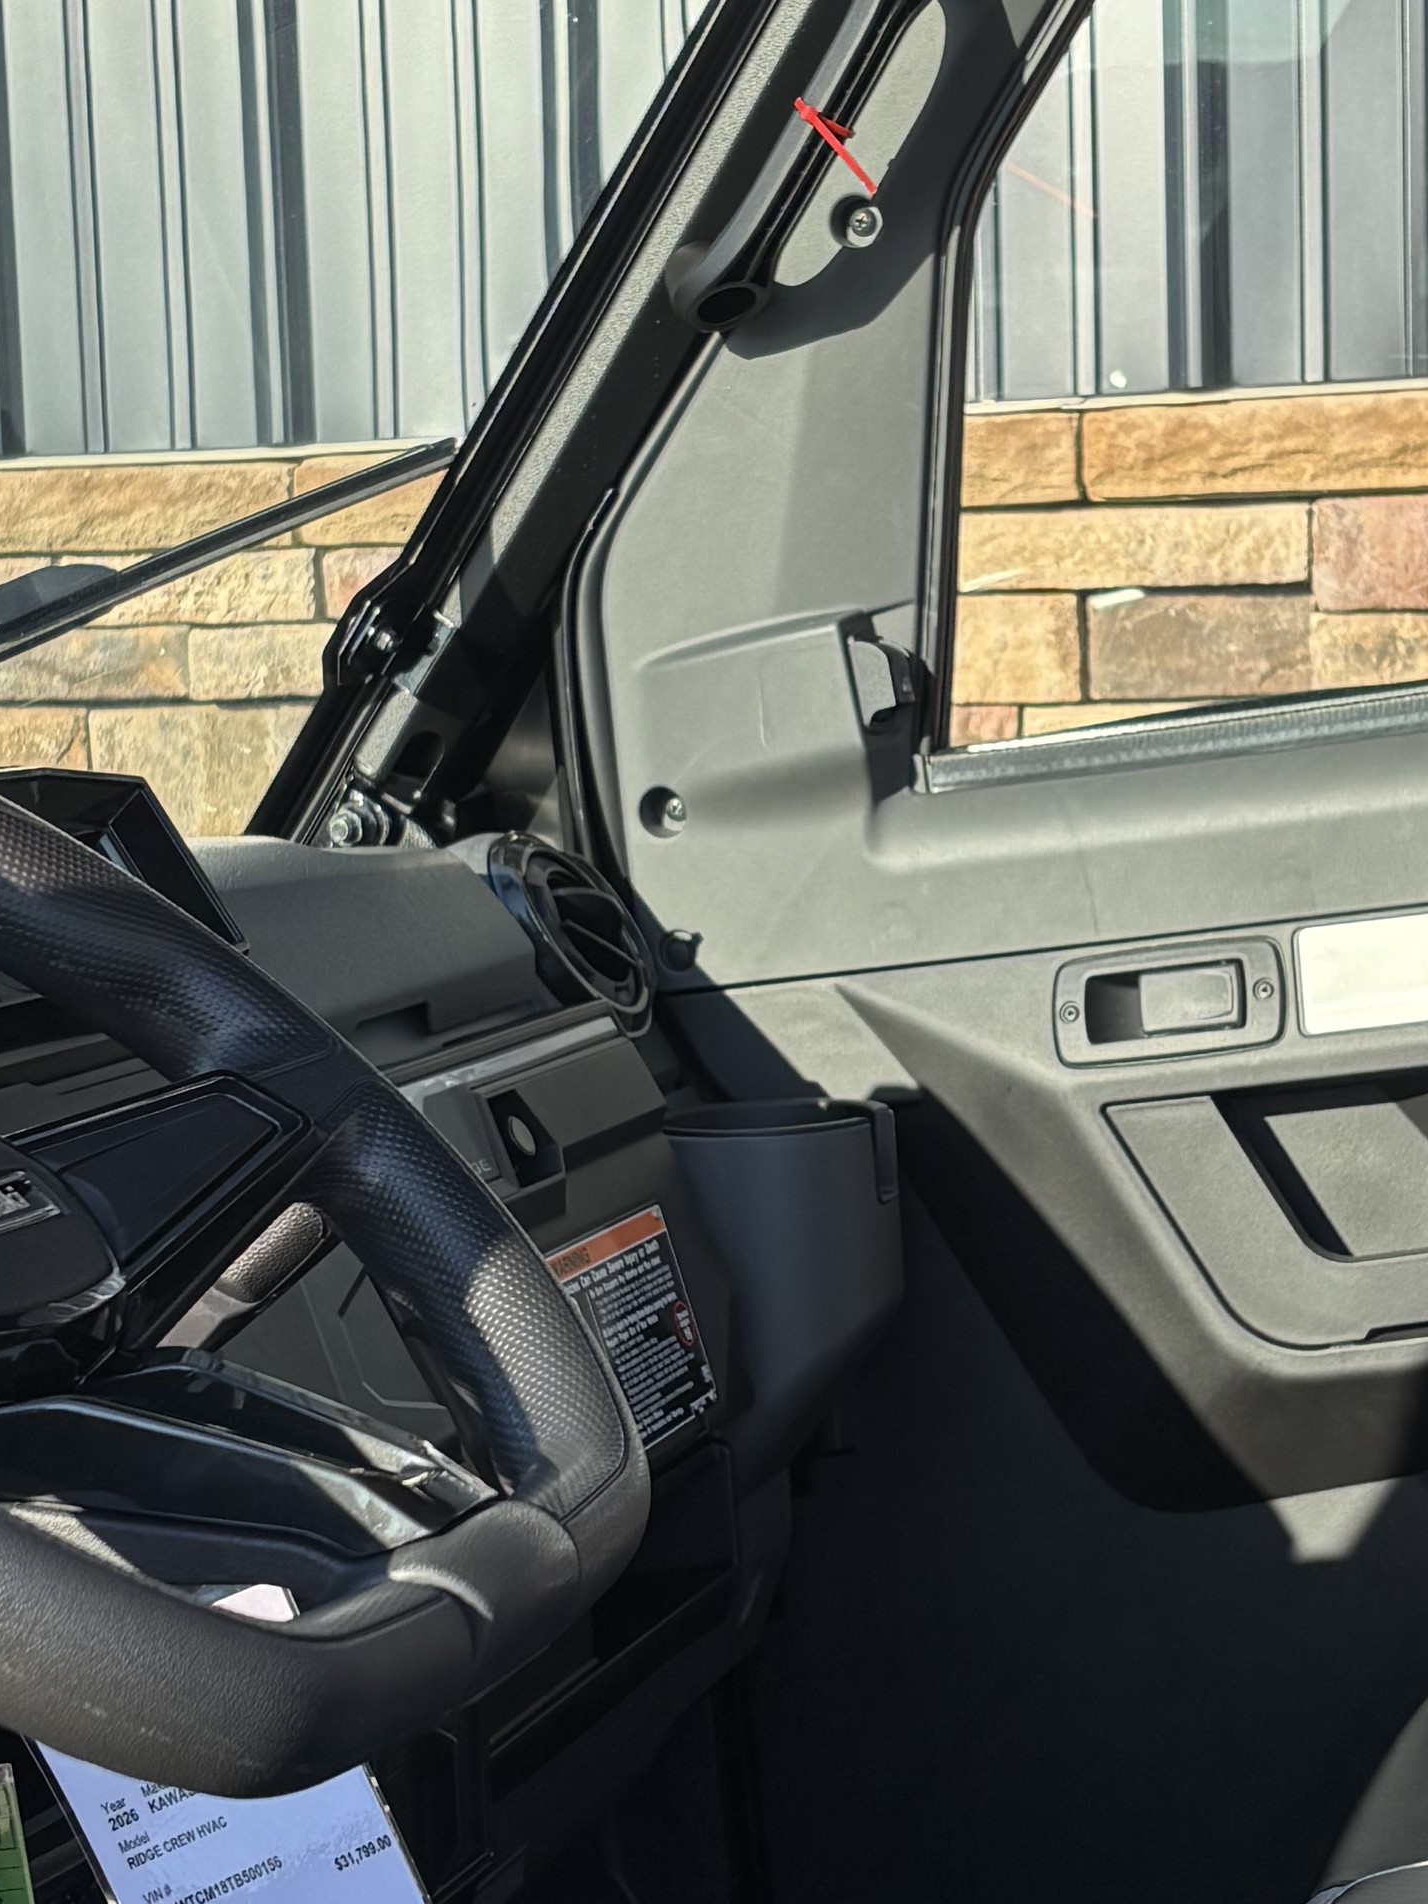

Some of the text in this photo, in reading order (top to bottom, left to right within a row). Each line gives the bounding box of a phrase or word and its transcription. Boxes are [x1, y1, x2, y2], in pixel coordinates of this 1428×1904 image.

[100, 1797, 127, 1815] Year
[108, 1808, 140, 1831] 2026
[118, 1831, 151, 1855] Model
[127, 1815, 228, 1870] RIDGE CREW HVAC
[334, 1834, 392, 1871] $31,799.00
[142, 1887, 164, 1904] VIN
